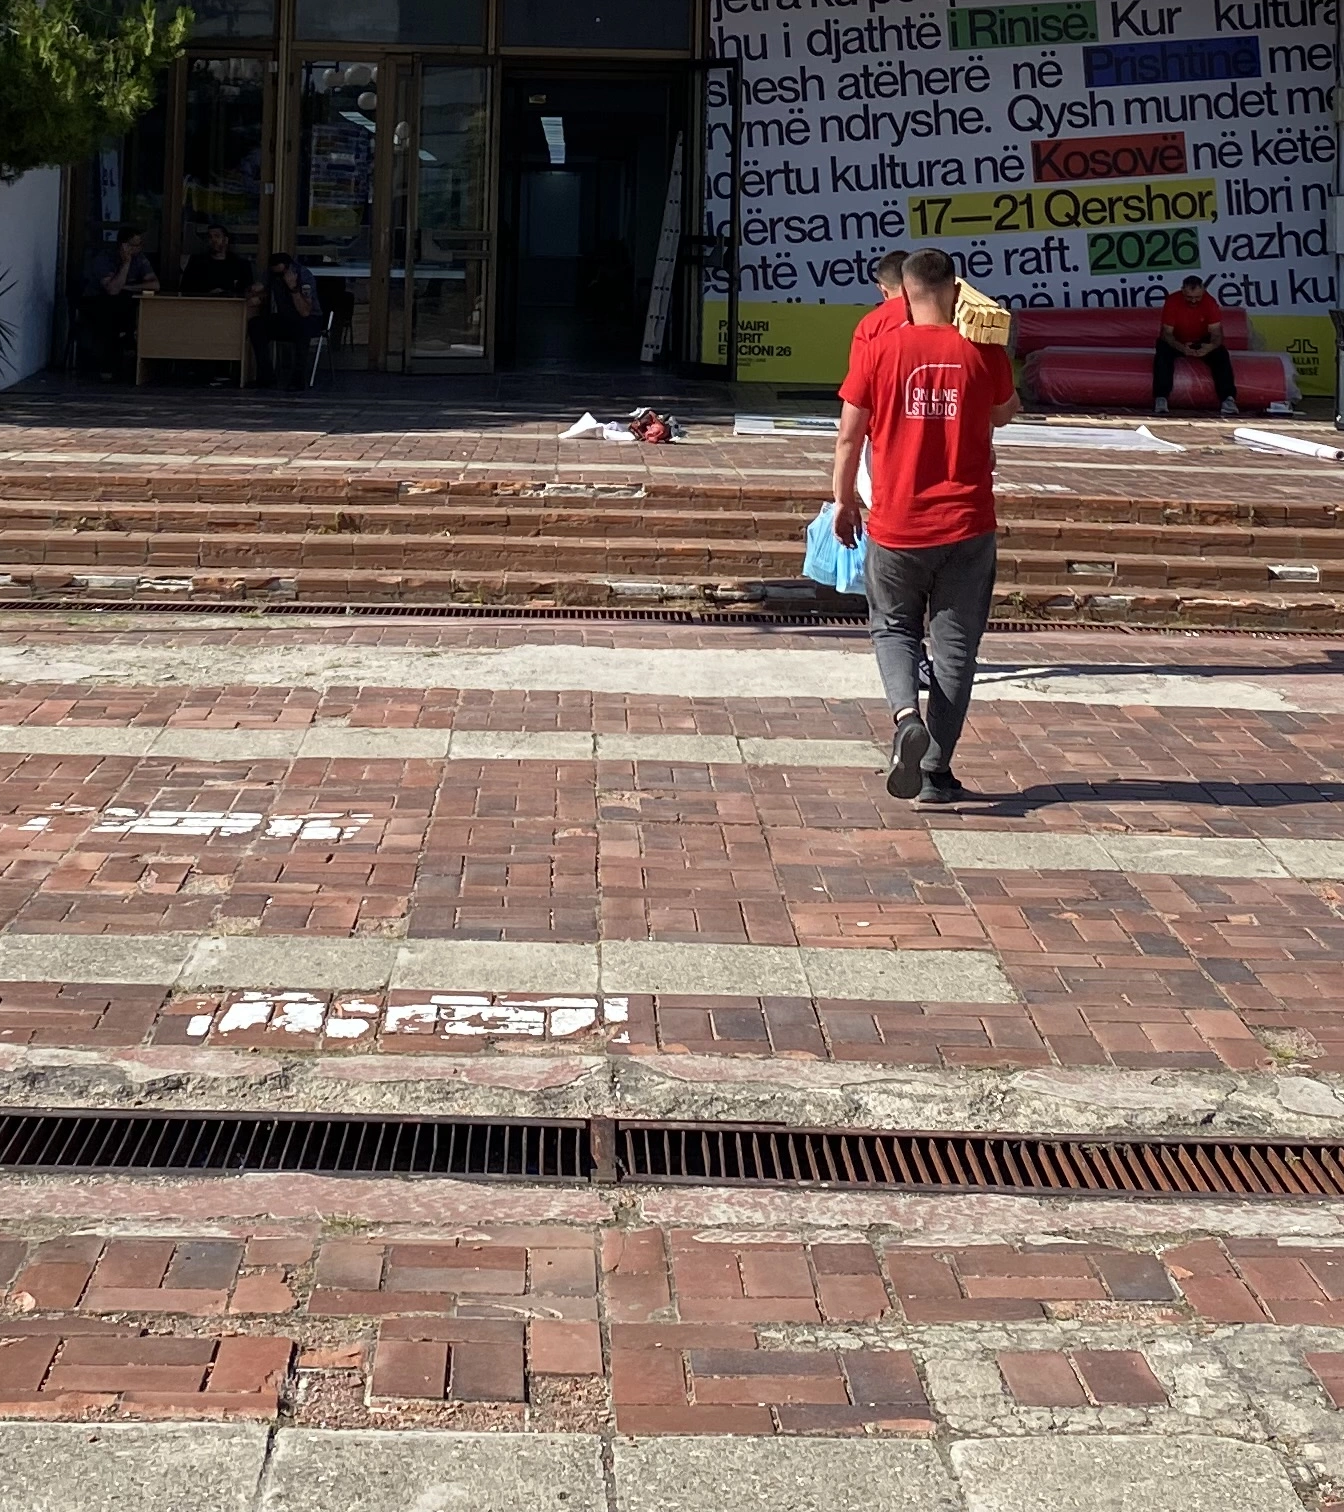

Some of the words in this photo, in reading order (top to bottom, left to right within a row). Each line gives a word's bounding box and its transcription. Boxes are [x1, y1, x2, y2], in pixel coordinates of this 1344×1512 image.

[709, 26, 767, 61] hu
[783, 22, 792, 59] i
[806, 11, 942, 63] djathtë
[950, 10, 959, 48] i
[968, 1, 1097, 48] Rinisë.
[1111, 0, 1182, 38] Kur
[837, 54, 990, 101] atëherë
[1013, 50, 1063, 89] në
[1086, 38, 1258, 87] Prishtinë
[820, 98, 993, 148] ndryshe.
[1007, 91, 1115, 139] Qysh
[1124, 81, 1278, 127] mundet
[830, 153, 967, 193] kultura
[975, 144, 1025, 185] në
[1033, 134, 1185, 181] Kosovë
[1192, 131, 1243, 171] në
[1251, 124, 1336, 167] këtë
[840, 199, 905, 241] më
[1044, 184, 1218, 229] Qershor,
[1225, 176, 1293, 216] libri
[1003, 236, 1080, 277] raft.
[1089, 226, 1201, 273] 2026
[1288, 269, 1337, 305] ku
[775, 345, 792, 357] 26
[912, 402, 958, 417] STUDIO
